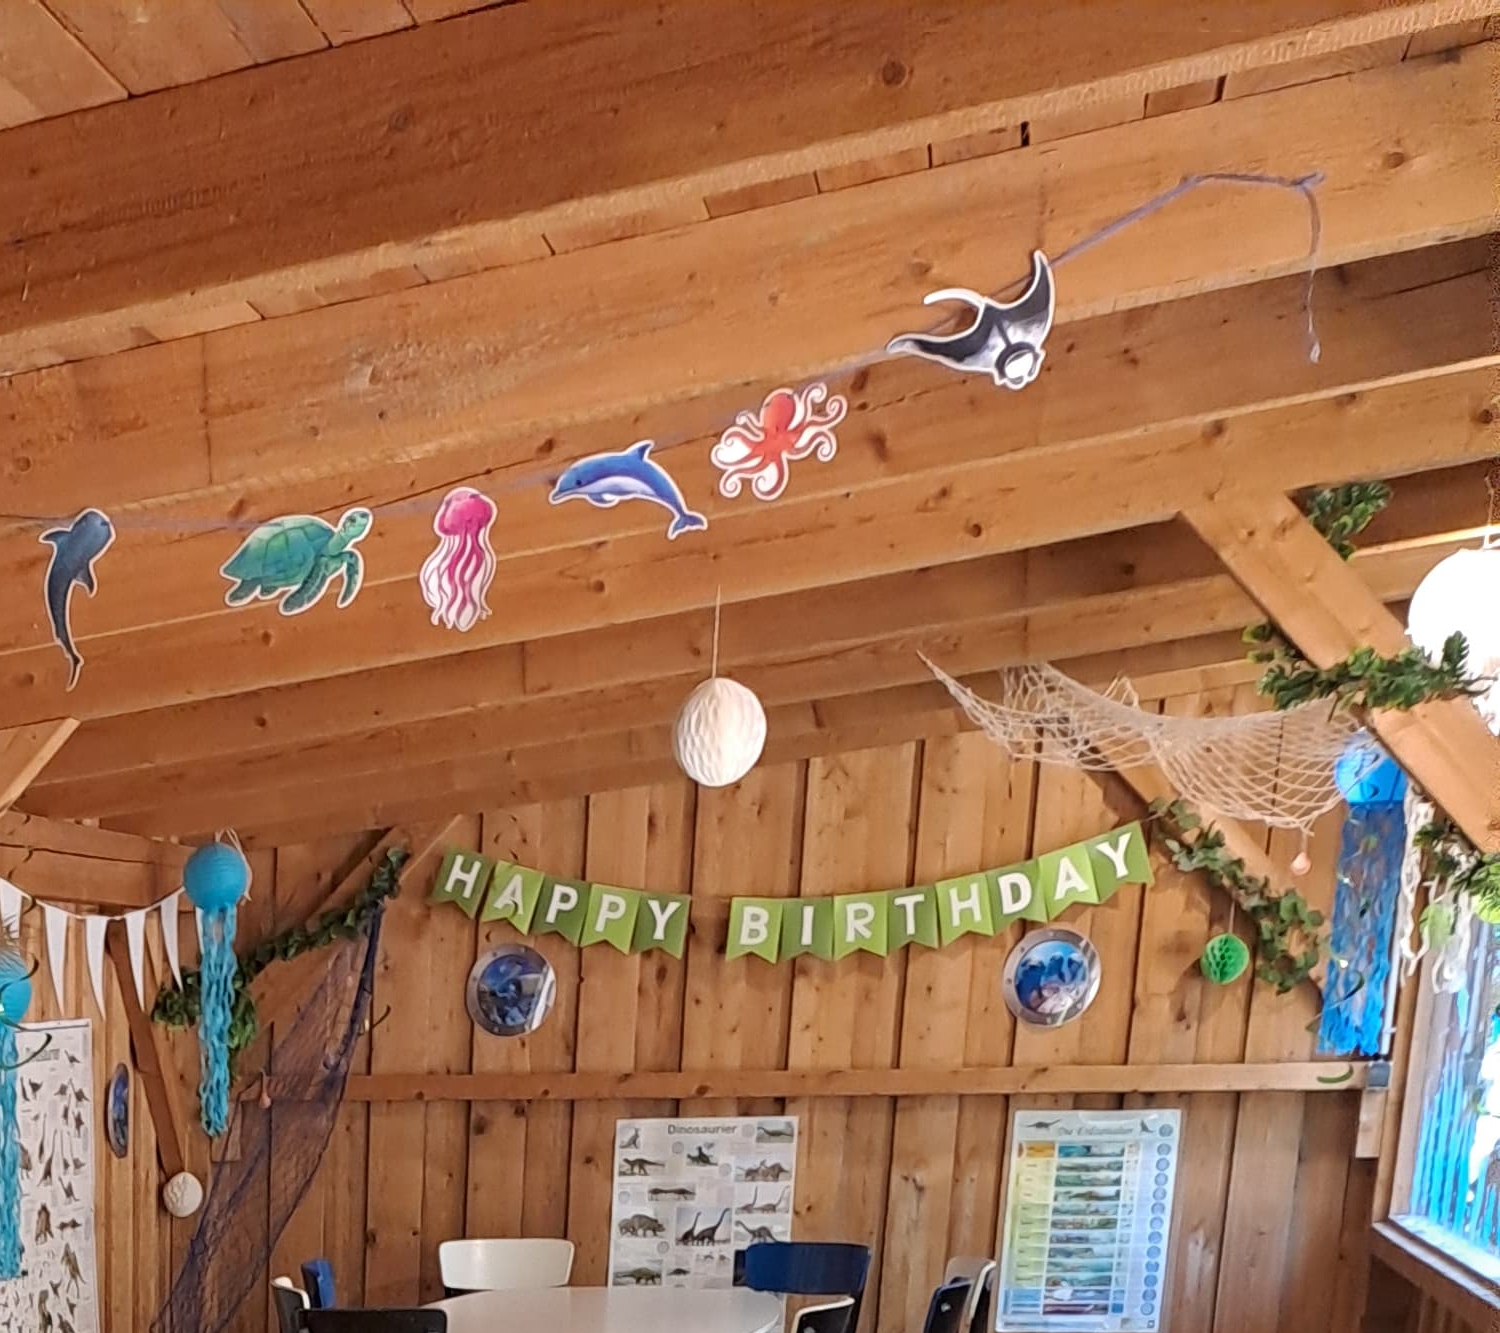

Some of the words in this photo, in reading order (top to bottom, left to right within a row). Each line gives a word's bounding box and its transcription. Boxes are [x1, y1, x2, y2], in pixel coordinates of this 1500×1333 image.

[445, 853, 683, 942] HAPPY
[738, 832, 1134, 948] BIRTHDAY
[667, 1124, 737, 1135] Dinosaurier
